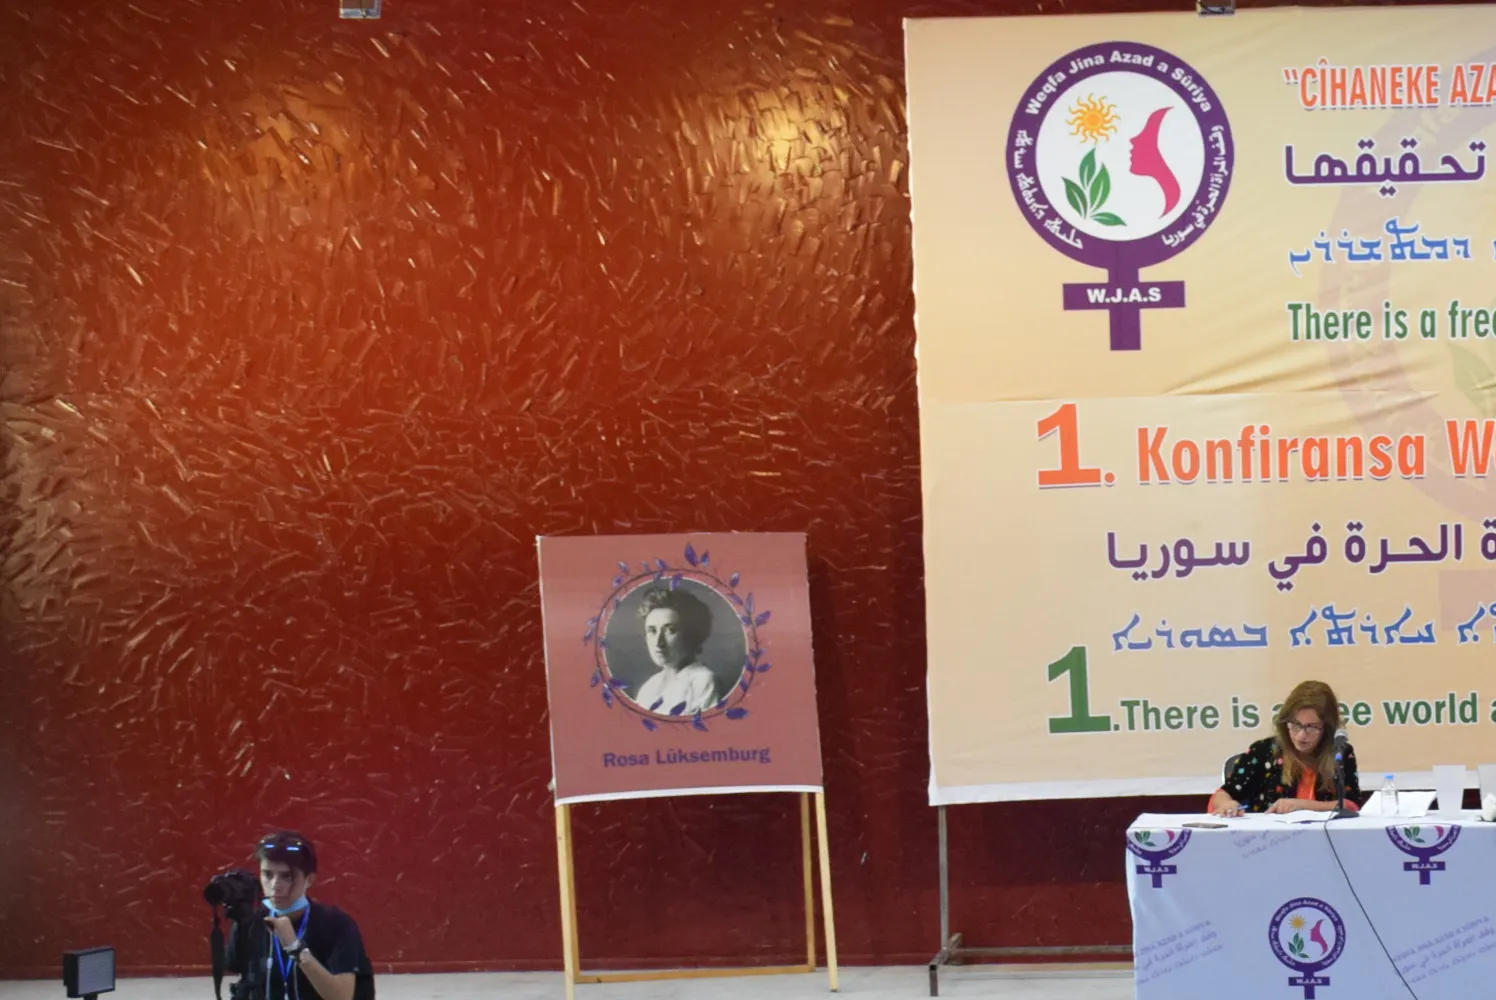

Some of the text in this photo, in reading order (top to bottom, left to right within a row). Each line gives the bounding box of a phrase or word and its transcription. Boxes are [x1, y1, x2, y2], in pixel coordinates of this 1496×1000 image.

[1025, 71, 1066, 115] Weqfa
[1068, 53, 1105, 75] Jina
[1110, 51, 1154, 67] Azad
[1157, 62, 1169, 73] a
[1287, 140, 1485, 194] تحقيقها
[1160, 217, 1196, 250] سوريا
[1087, 287, 1161, 304] W.J.A.S
[1288, 304, 1370, 338] There
[1385, 303, 1407, 337] is
[1421, 311, 1435, 336] a
[1139, 426, 1424, 480] Konfiransa
[1109, 533, 1248, 579] سوريا
[1269, 525, 1326, 590] في
[1346, 523, 1461, 573] الحرة
[1232, 697, 1260, 728] is
[1384, 693, 1478, 724] world
[602, 751, 649, 768] Rosa
